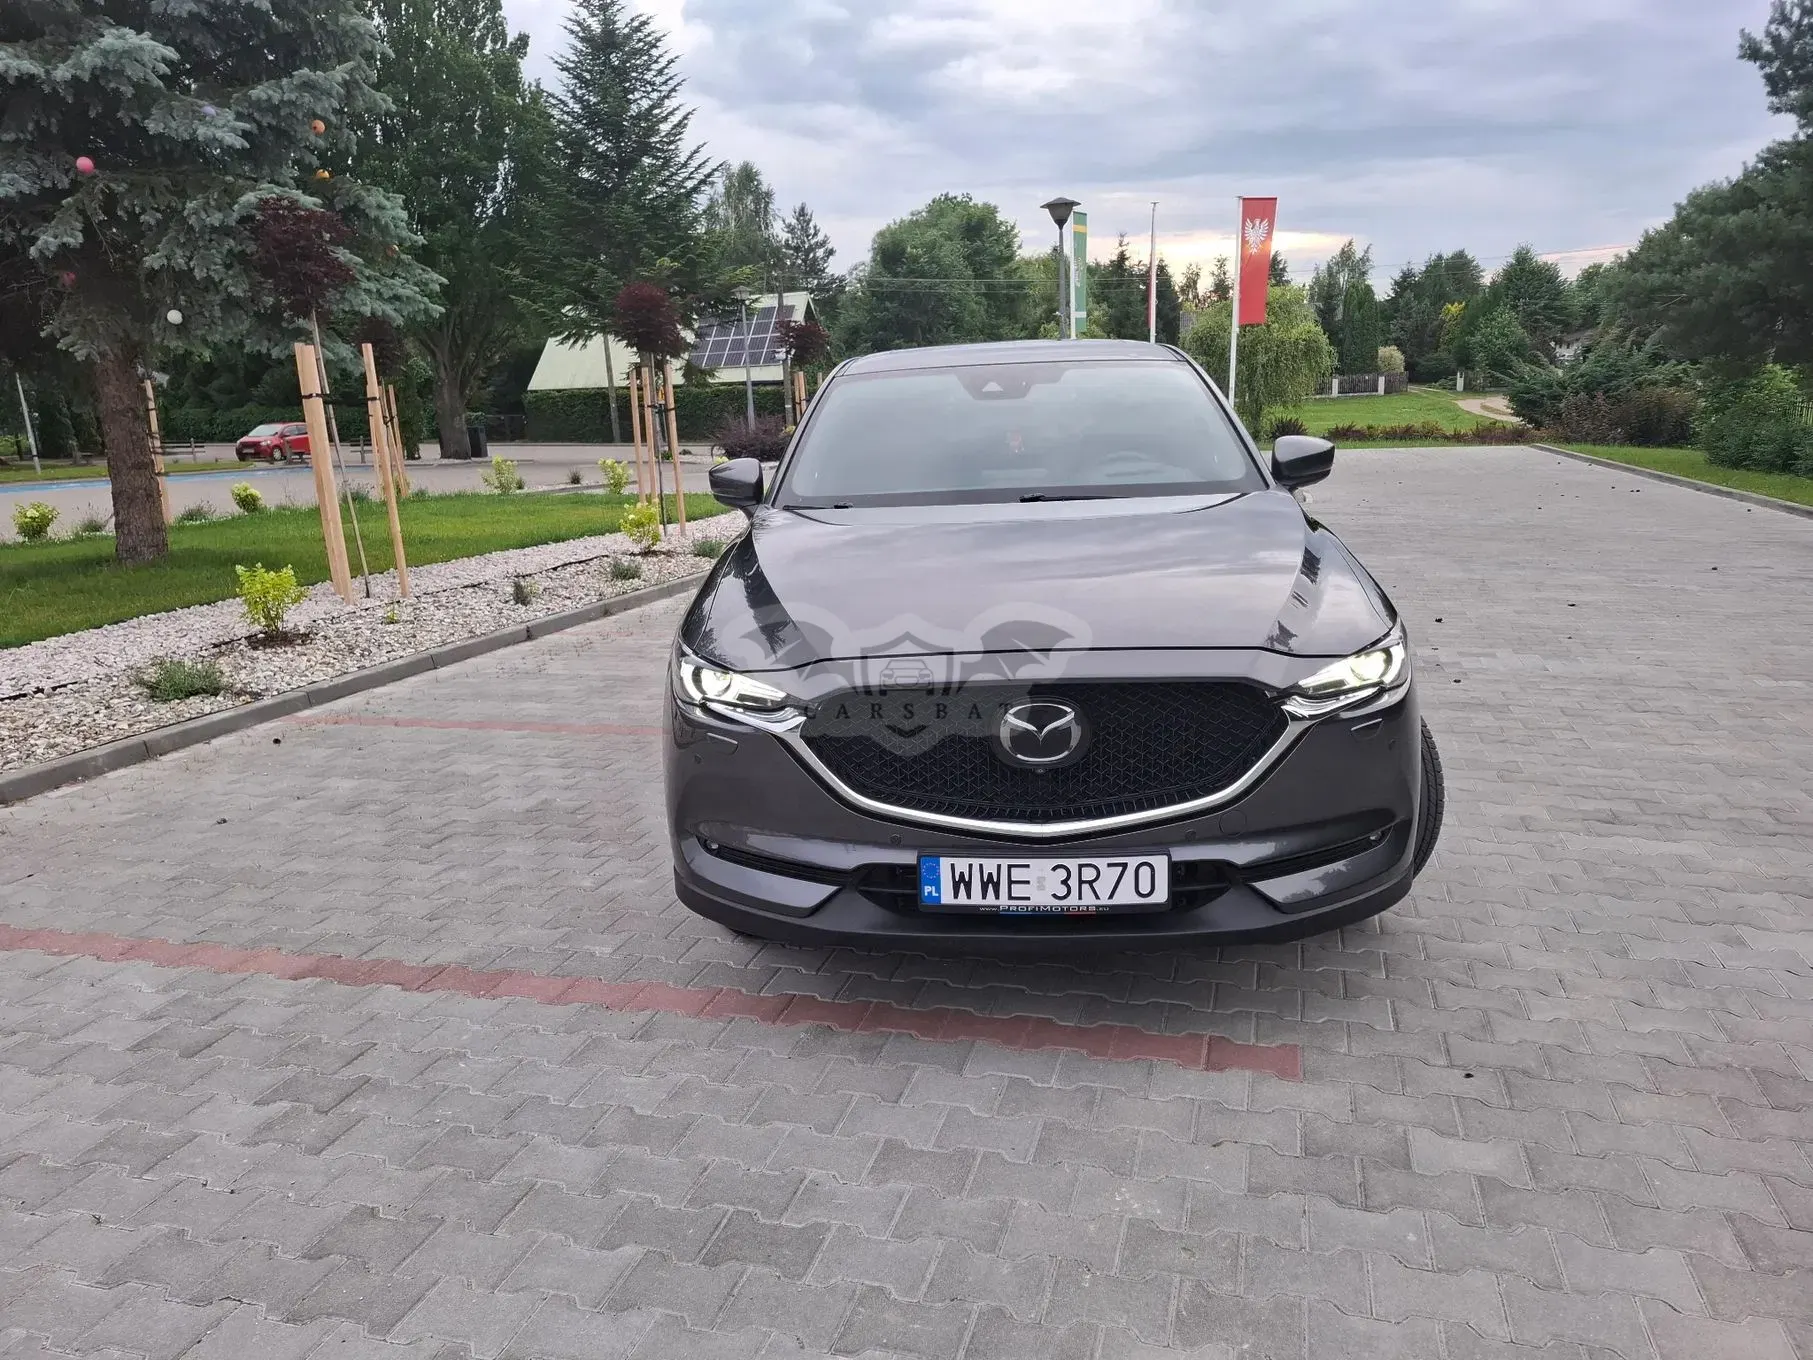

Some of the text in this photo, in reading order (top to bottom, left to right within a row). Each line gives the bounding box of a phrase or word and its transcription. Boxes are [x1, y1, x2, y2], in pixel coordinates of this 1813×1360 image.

[924, 886, 939, 897] PL
[950, 861, 1156, 901] WWE 3R70
